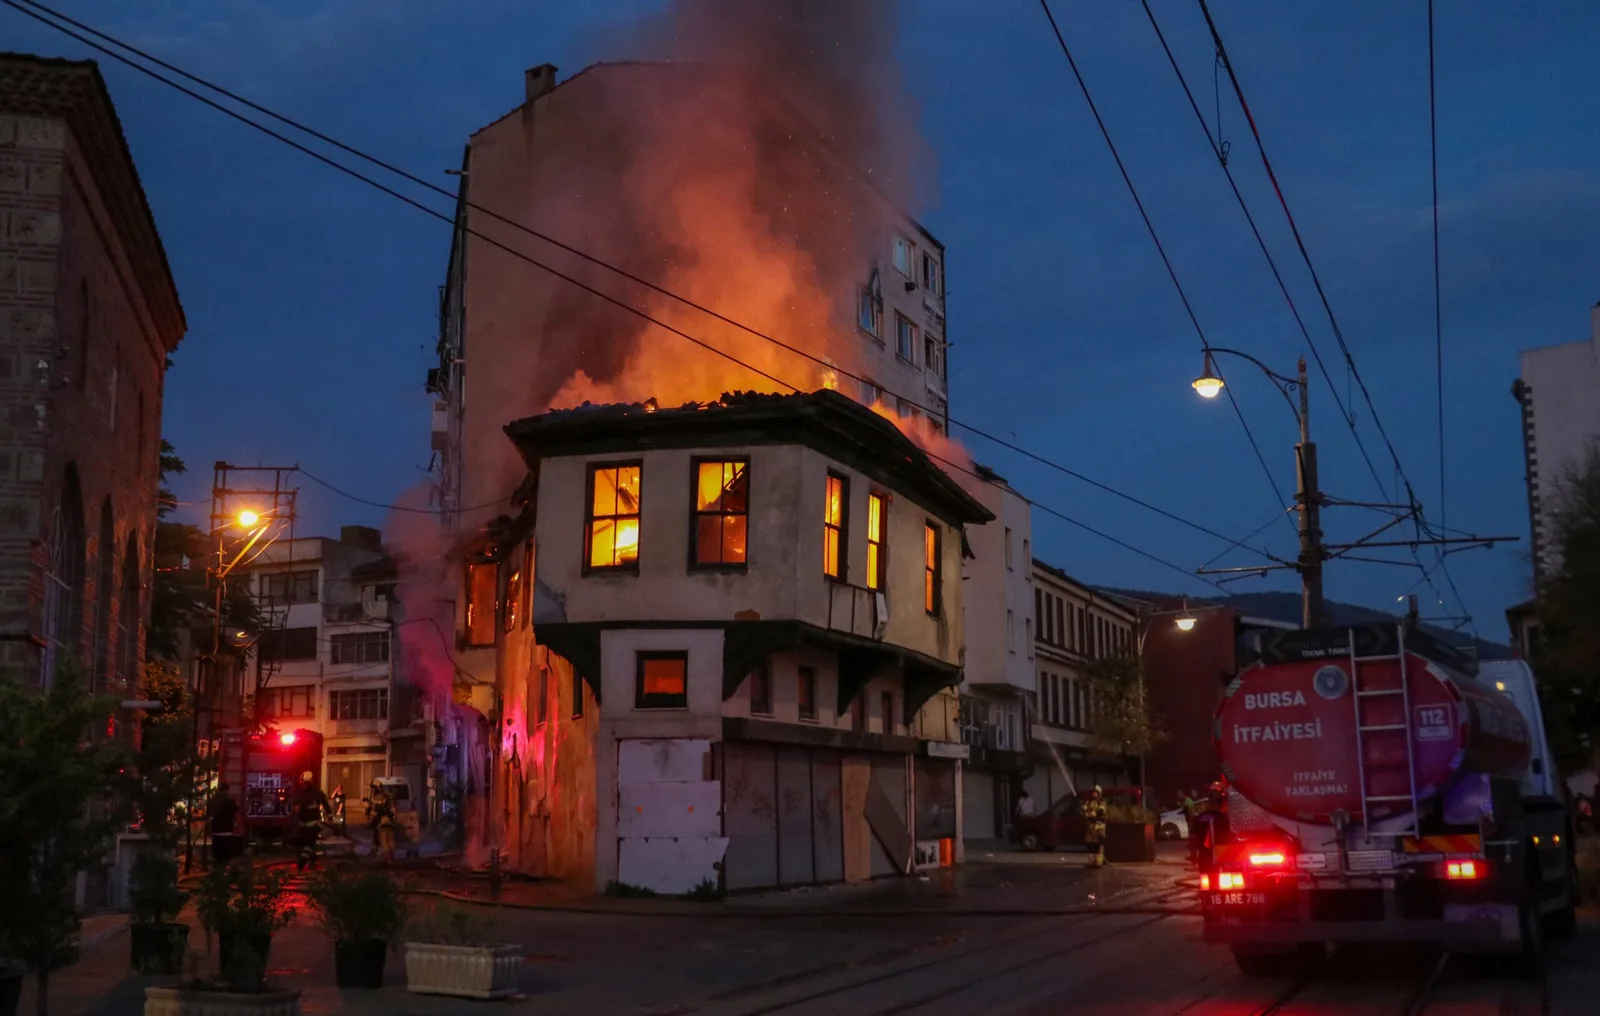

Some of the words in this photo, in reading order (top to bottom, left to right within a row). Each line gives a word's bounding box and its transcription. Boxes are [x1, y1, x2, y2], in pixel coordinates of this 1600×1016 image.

[1244, 690, 1306, 709] BURSA
[1420, 708, 1445, 725] 112
[1233, 718, 1322, 743] İTFAİYESİ
[1211, 895, 1222, 905] 16
[1224, 893, 1244, 905] ARE
